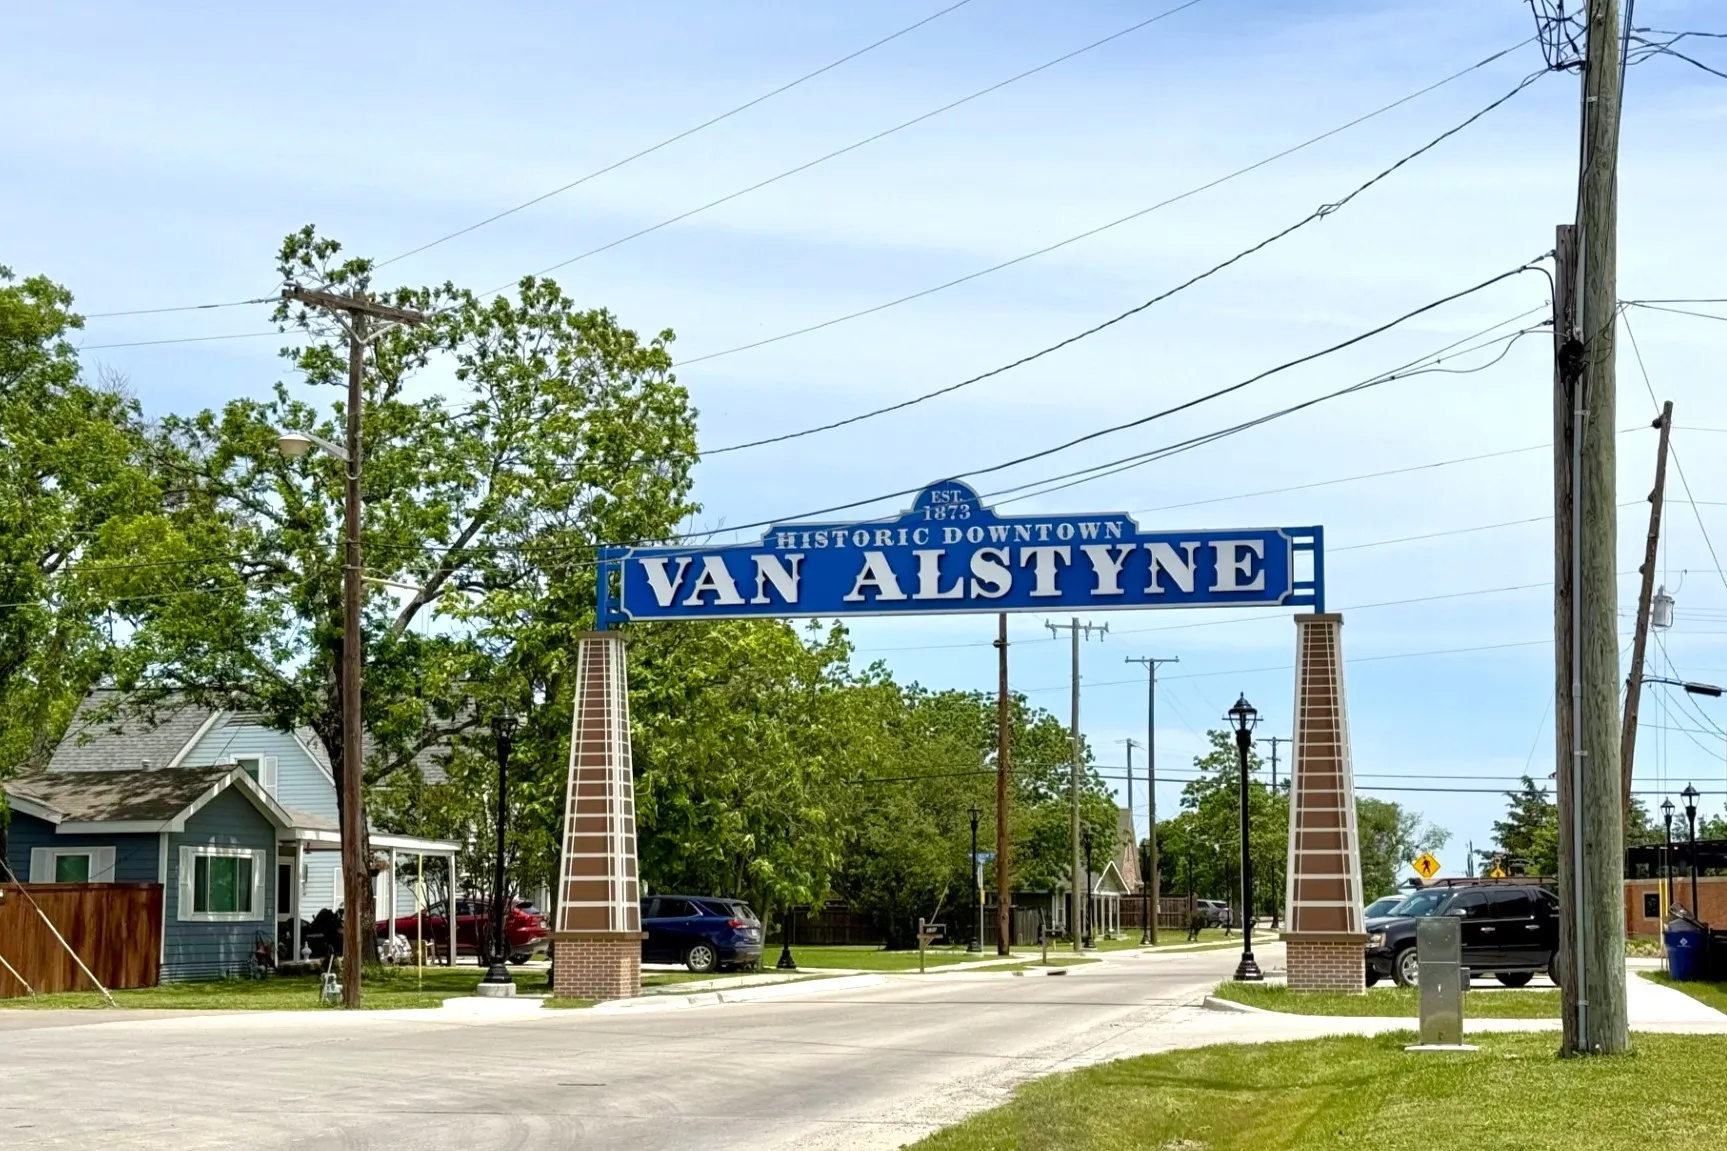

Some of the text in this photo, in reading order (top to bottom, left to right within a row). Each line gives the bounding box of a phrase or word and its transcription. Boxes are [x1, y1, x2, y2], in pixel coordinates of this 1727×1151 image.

[931, 490, 963, 504] EST.
[923, 504, 971, 521] 1873
[775, 521, 1123, 549] HISTORIC DOWNTOWN
[638, 539, 1266, 607] VAN ALSTYNE
